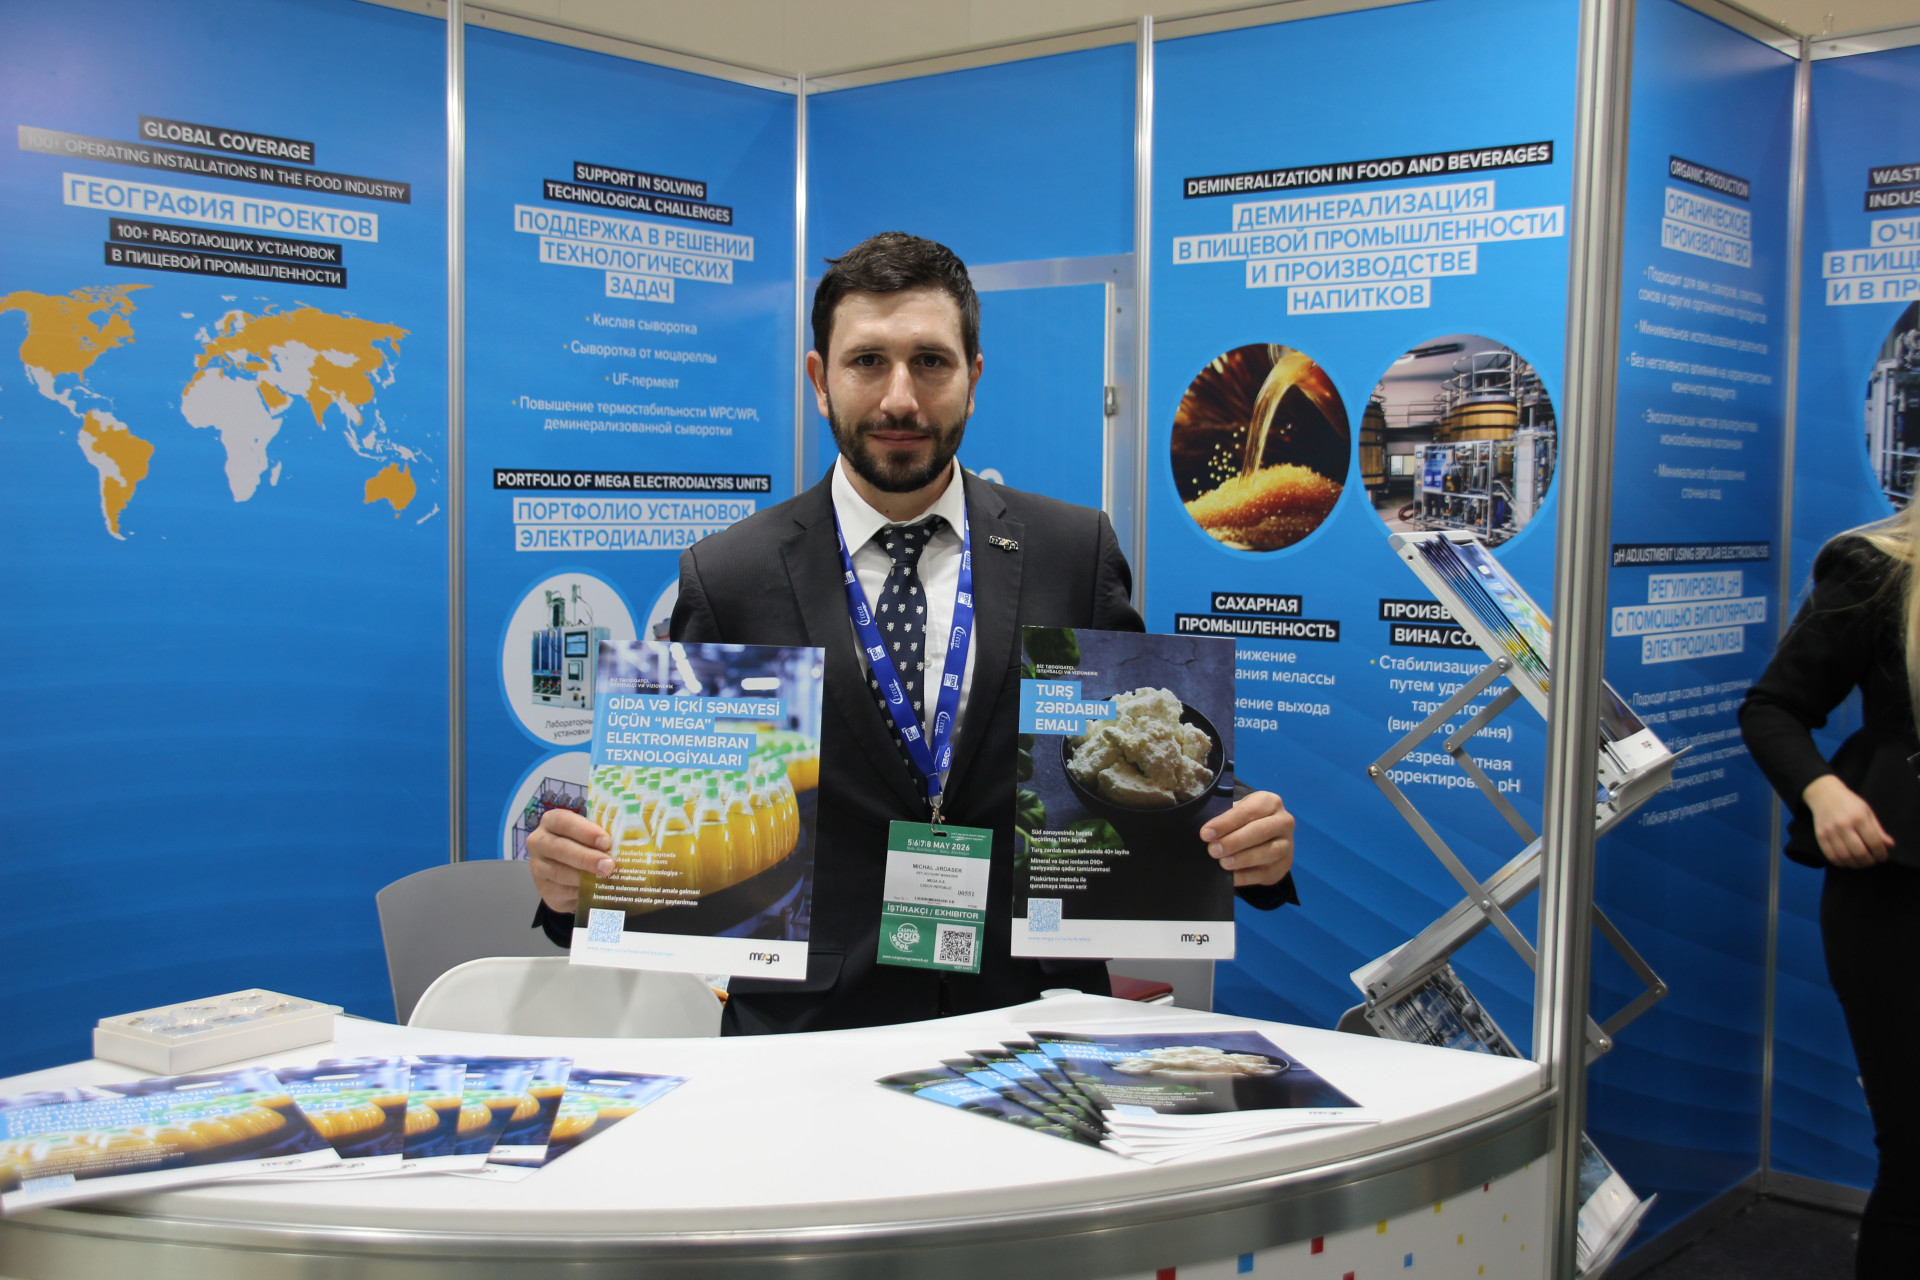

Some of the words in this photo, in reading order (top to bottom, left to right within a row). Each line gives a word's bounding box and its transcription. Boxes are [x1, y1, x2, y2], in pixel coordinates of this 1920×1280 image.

[144, 122, 215, 147] GLOBAL
[219, 133, 310, 160] COVERAGE
[65, 138, 149, 164] OPERATING
[154, 151, 257, 180] INSTALLATIONS
[260, 167, 274, 181] IN
[277, 170, 302, 185] THE
[305, 173, 342, 190] FOOD
[345, 180, 405, 199] INDUSTRY
[1188, 168, 1332, 195] DEMINERALIZATION
[1336, 165, 1353, 180] IN
[1357, 162, 1403, 178] FOOD
[1407, 157, 1443, 174] AND
[1448, 146, 1548, 171] BEVERAGES
[1671, 159, 1704, 183] ORGANIC
[1705, 170, 1748, 197] PRODUCTION
[1872, 167, 1920, 185] WAST
[577, 166, 635, 187] SUPPORT
[638, 175, 651, 189] IN
[653, 177, 704, 198] SOLVING
[71, 180, 236, 221] ГЕОГРАФИЯ
[243, 203, 373, 238] ПРОЕКТОВ
[547, 183, 652, 212] TECHNOLOGICAL
[654, 200, 730, 223] CHALLENGES
[1237, 187, 1487, 229] ДЕМИНЕРАЛИЗАЦИЯ
[1869, 190, 1920, 208] INDUS
[1667, 194, 1748, 234] ОРГАНИЧЕСКОЕ
[118, 224, 149, 241] 100+
[153, 229, 254, 253] РАБОТАЮЩИХ
[257, 240, 336, 261] УСТАНОВОК
[519, 210, 643, 243] ПОДДЕРЖКА
[648, 228, 660, 245] В
[665, 230, 750, 258] РЕШЕНИИ
[1179, 243, 1192, 259] В
[1198, 229, 1307, 261] ПИЩЕВОЙ
[1314, 212, 1557, 250] ПРОМЫШЛЕННОСТИ
[1664, 224, 1749, 264] ПРОИЗВОДСТВО
[112, 248, 123, 262] В
[125, 247, 201, 271] ПИЩЕВОЙ
[204, 258, 341, 284] ПРОМЫШЛЕННОСТИ
[544, 241, 729, 280] ТЕХНОЛОГИЧЕСКИХ
[1252, 265, 1267, 284] И
[1275, 250, 1471, 282] ПРОИЗВОДСТВЕ
[1830, 256, 1846, 274] В
[610, 276, 671, 301] ЗАДАЧ
[1293, 285, 1425, 311] НАПИТКОВ
[1833, 283, 1850, 302] И
[1860, 281, 1874, 300] В
[1883, 279, 1920, 299] ПР
[593, 313, 635, 329] Кислая
[638, 319, 698, 335] сыворотка
[571, 340, 637, 359] Сыворотка
[639, 347, 652, 359] от
[654, 349, 717, 365] моцареллы
[612, 373, 679, 390] UF-пермеат
[520, 396, 594, 413] Повышение
[597, 401, 707, 419] термостабильности
[544, 417, 672, 434] деминерализованной
[675, 423, 732, 438] сыворотки
[497, 472, 571, 487] PORTFOLIO
[574, 474, 591, 488] OF
[594, 475, 631, 488] MEGA
[633, 475, 734, 490] ELECTRODIALYSIS
[736, 477, 769, 490] UNITS
[518, 502, 642, 521] ПОРТФОЛИО
[648, 503, 752, 521] УСТАНОВОК
[520, 529, 697, 550] ЭЛЕКТРОДИАЛИЗА
[1626, 548, 1673, 562] ADJUSTMENT
[1651, 576, 1725, 599] РЕГУЛИРОВКА
[1215, 596, 1298, 613] САХАРНАЯ
[1615, 611, 1624, 632] С
[1627, 606, 1691, 631] ПОМОЩЬЮ
[1694, 601, 1763, 625] БИПОЛЯРНОГО
[1179, 617, 1336, 639] ПРОМЫШЛЕННОСТЬ
[1645, 631, 1741, 660] ЭЛЕКТРОДИАЛИЗА
[1235, 650, 1296, 664] нижение
[1380, 655, 1488, 676] Стабилизация
[1235, 668, 1268, 681] ания
[1272, 670, 1335, 686] мелассы
[1390, 678, 1434, 695] путем
[1036, 684, 1073, 700] TURŞ
[609, 696, 645, 711] QİDA
[649, 699, 670, 711] VƏ
[674, 697, 702, 715] İÇKİ
[706, 701, 780, 716] SƏNAYESİ
[1036, 701, 1109, 716] ZƏRDABIN
[1277, 700, 1331, 717] выхода
[608, 712, 650, 729] ÜÇÜN
[1035, 719, 1078, 732] EMALI
[607, 732, 749, 749] ELEKTROMEMBRAN
[606, 748, 742, 766] TEXNOLOGİYALARI
[1498, 779, 1521, 793] pH
[933, 841, 950, 850] MAY
[952, 843, 970, 851] 2026
[935, 909, 979, 919] EXHIBITOR
